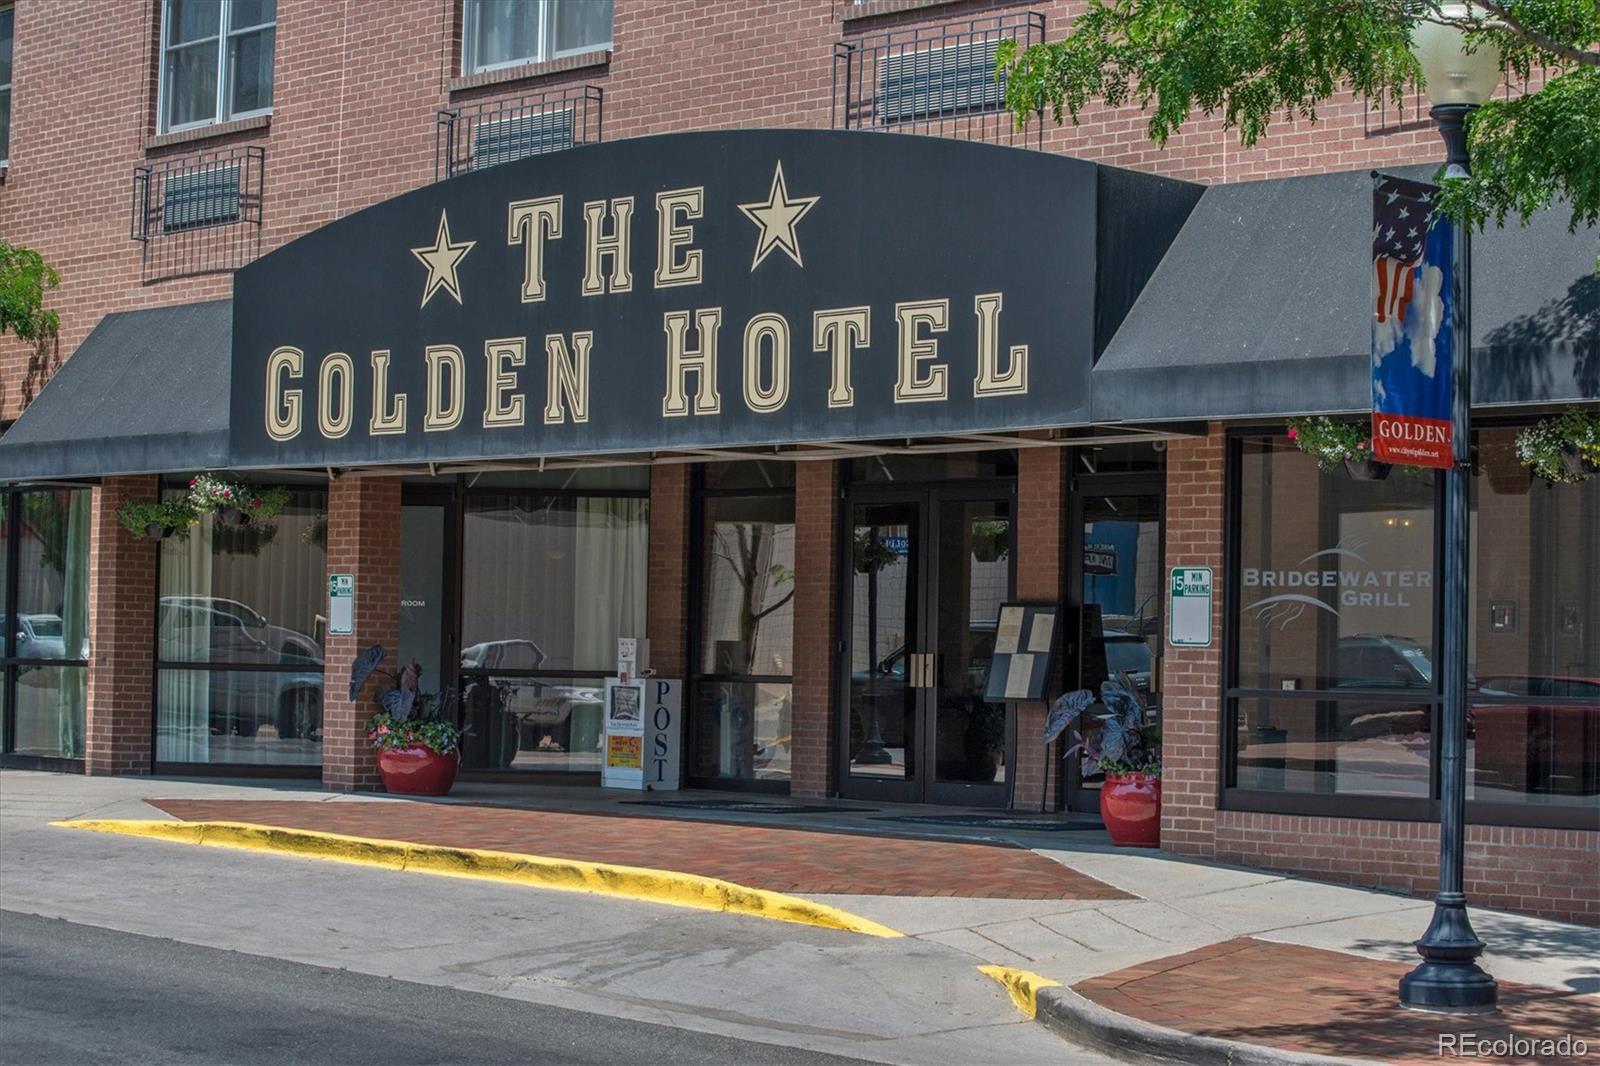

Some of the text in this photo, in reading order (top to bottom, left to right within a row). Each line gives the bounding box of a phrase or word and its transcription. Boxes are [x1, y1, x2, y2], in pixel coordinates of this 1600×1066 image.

[508, 186, 704, 303] THE
[265, 292, 1028, 442] GOLDEN HOTEL
[1172, 575, 1184, 591] 15
[1191, 572, 1203, 582] MIN
[1184, 584, 1210, 594] PARKING
[400, 599, 426, 607] ROOM
[1340, 590, 1410, 607] GRILL
[653, 681, 671, 782] POST
